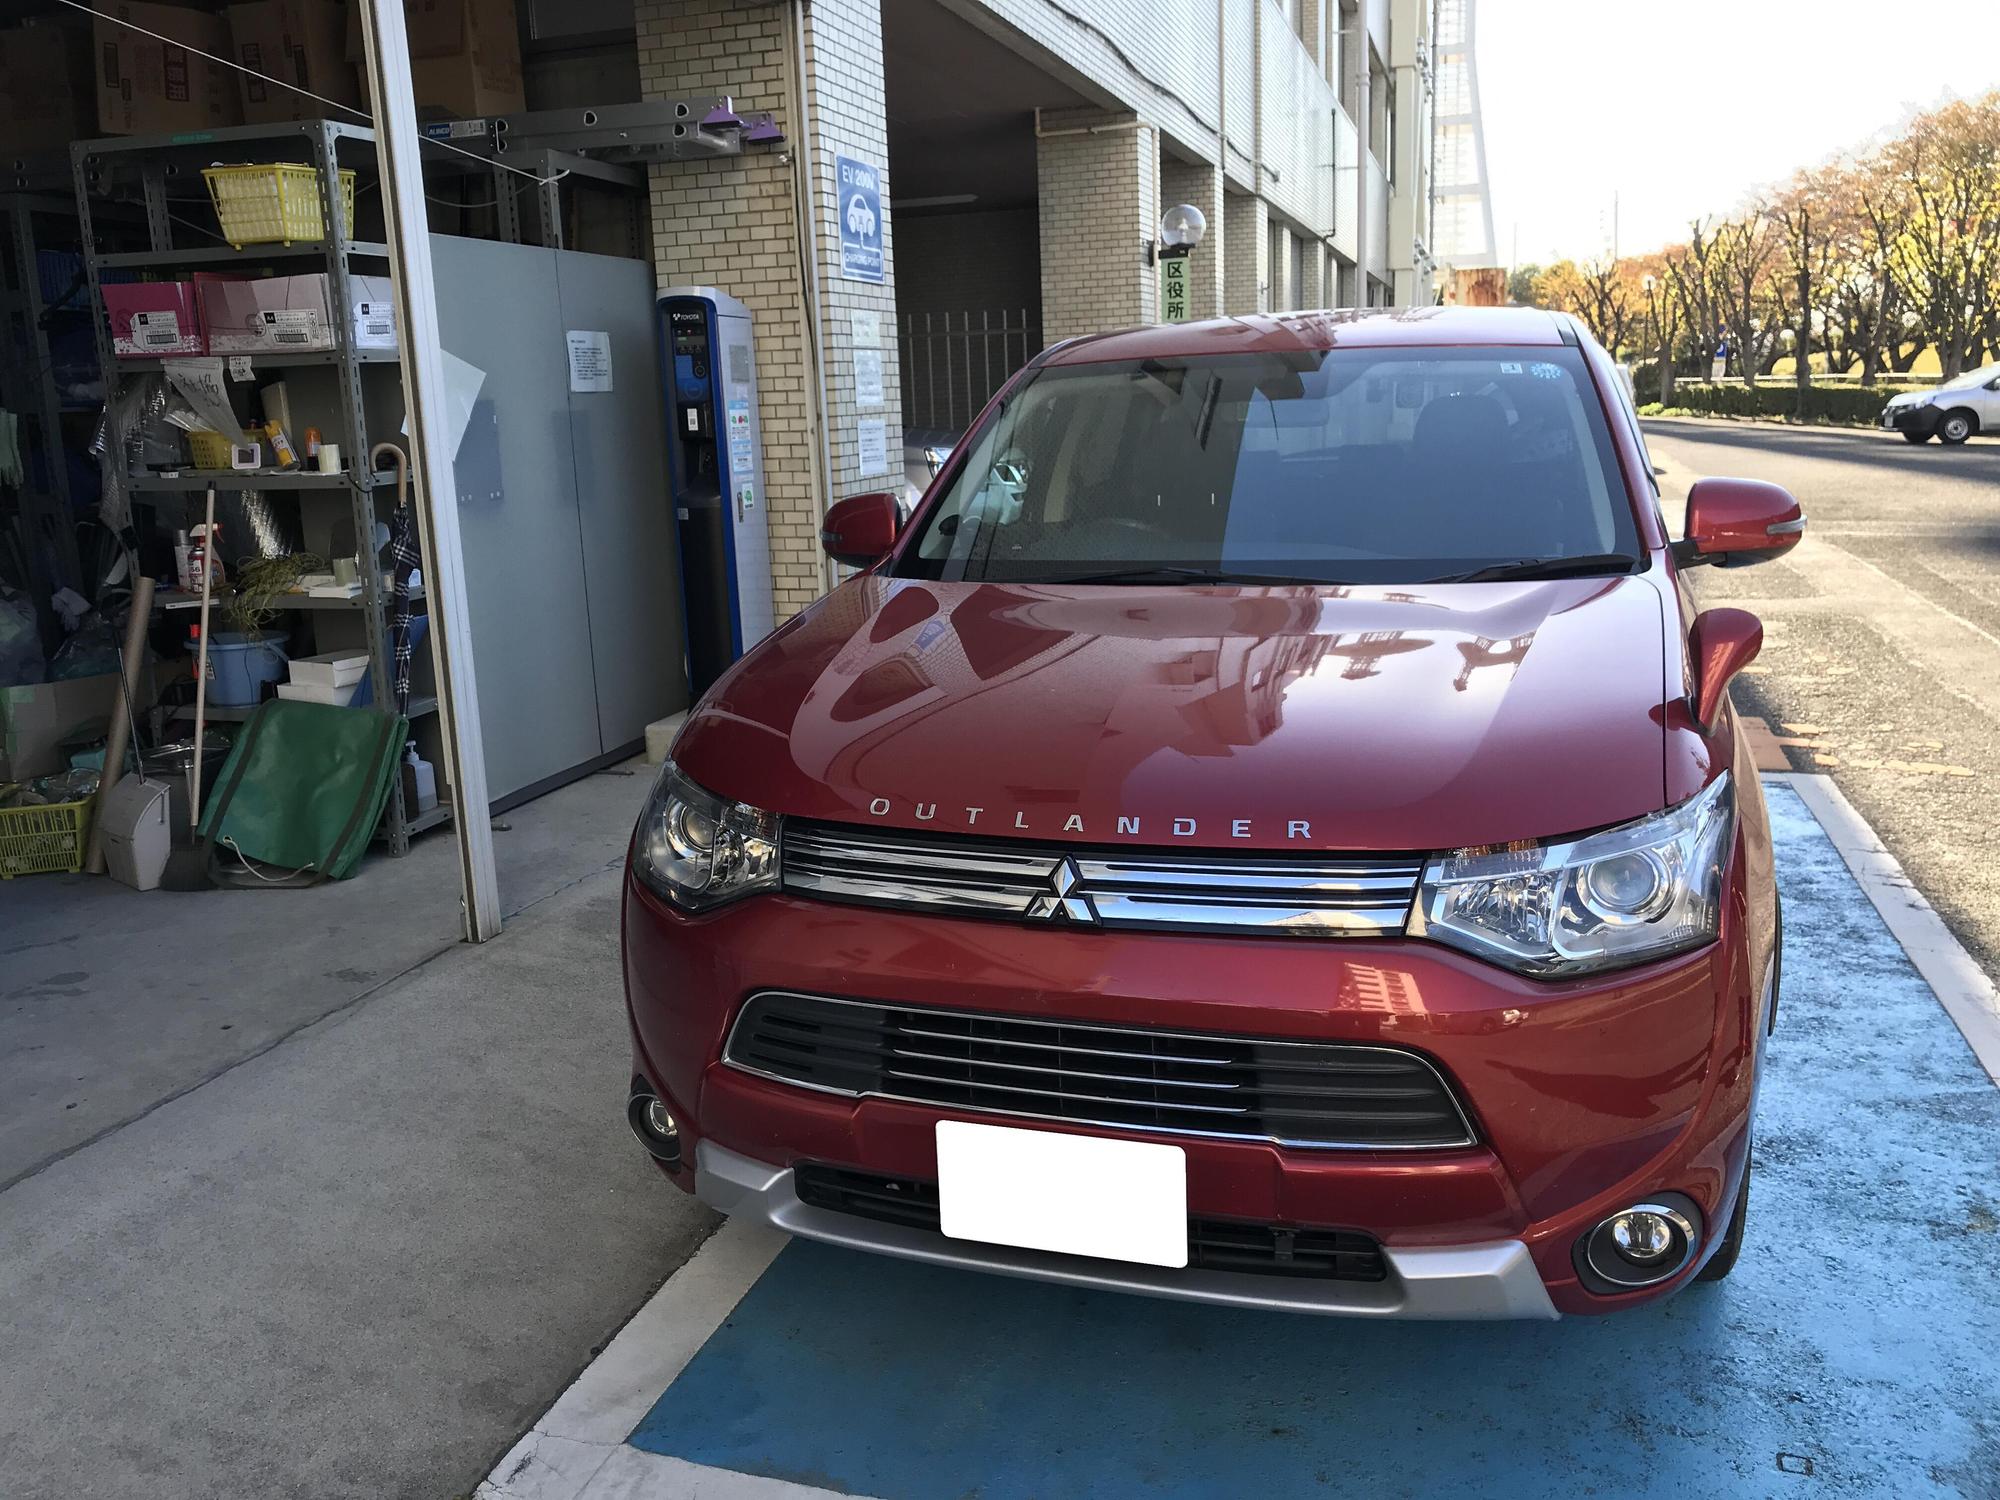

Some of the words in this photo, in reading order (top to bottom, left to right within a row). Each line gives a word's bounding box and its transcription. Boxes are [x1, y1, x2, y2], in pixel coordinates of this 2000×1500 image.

[842, 165, 854, 184] EV
[855, 169, 875, 190] 200V
[1167, 261, 1184, 319] 区役所
[681, 313, 699, 321] TOYOTA
[869, 798, 1313, 840] OUTLANDER
